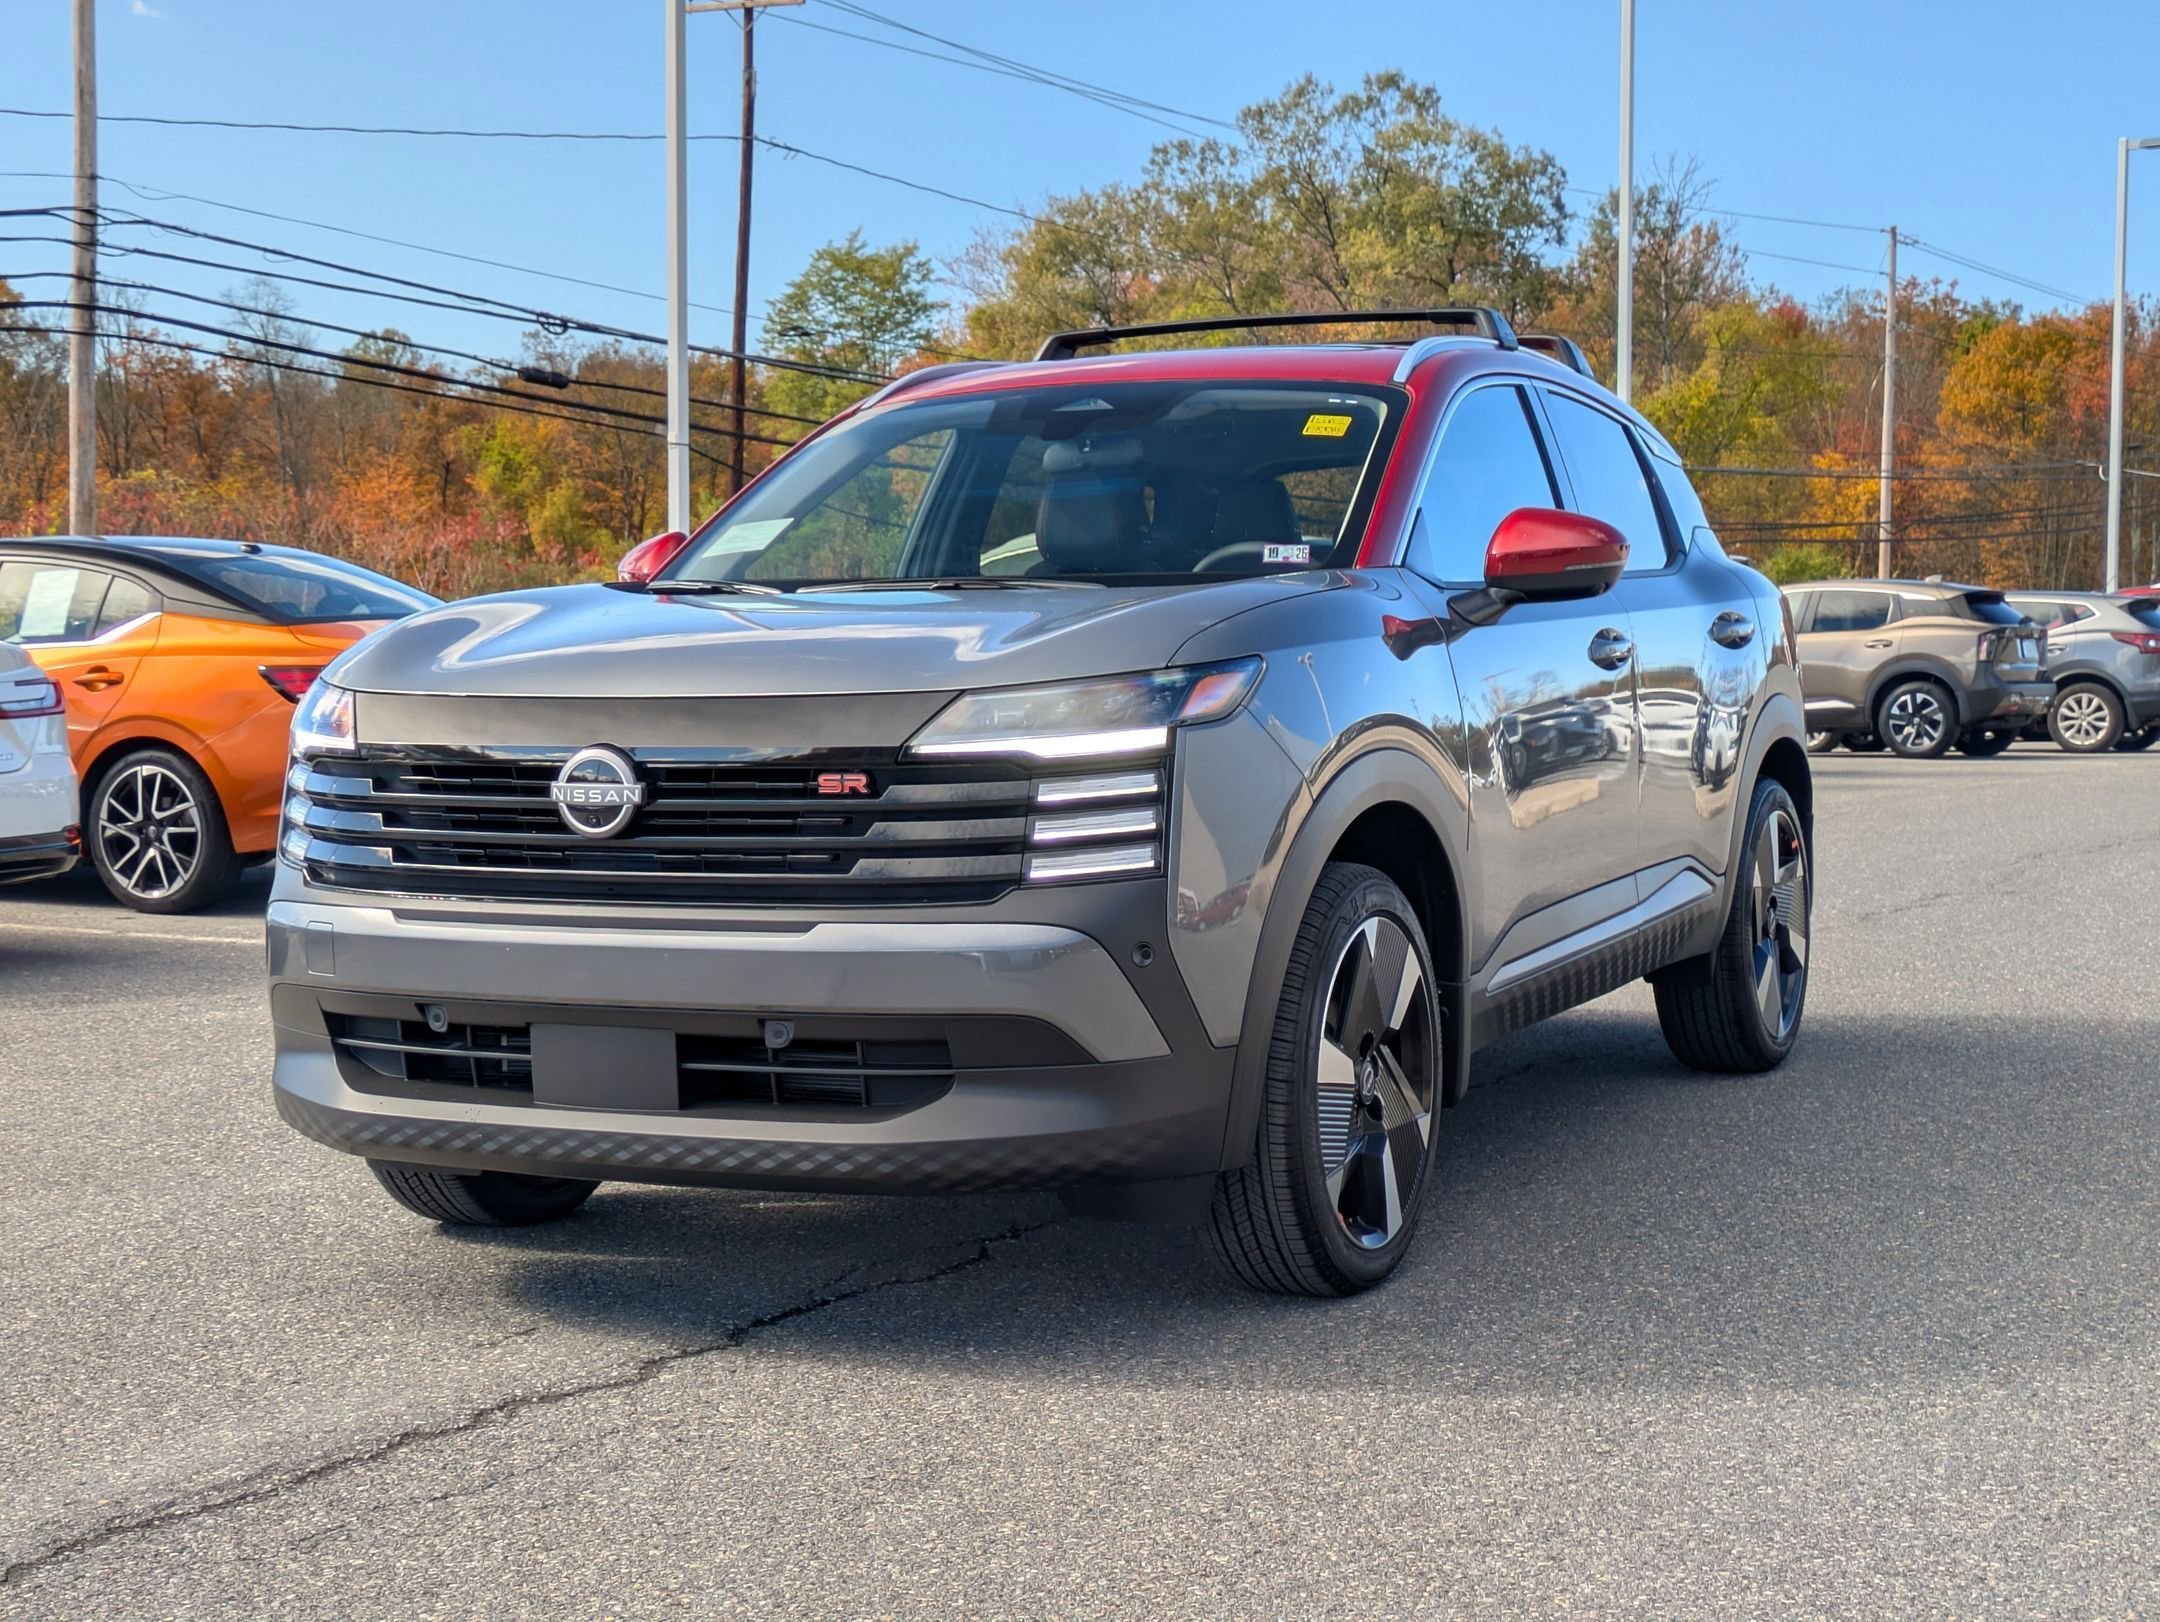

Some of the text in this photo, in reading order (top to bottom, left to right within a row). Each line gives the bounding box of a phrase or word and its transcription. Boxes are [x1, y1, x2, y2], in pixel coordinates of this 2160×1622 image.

[1296, 547, 1307, 560] 26
[818, 773, 869, 794] SR
[552, 786, 640, 803] NISSAN
